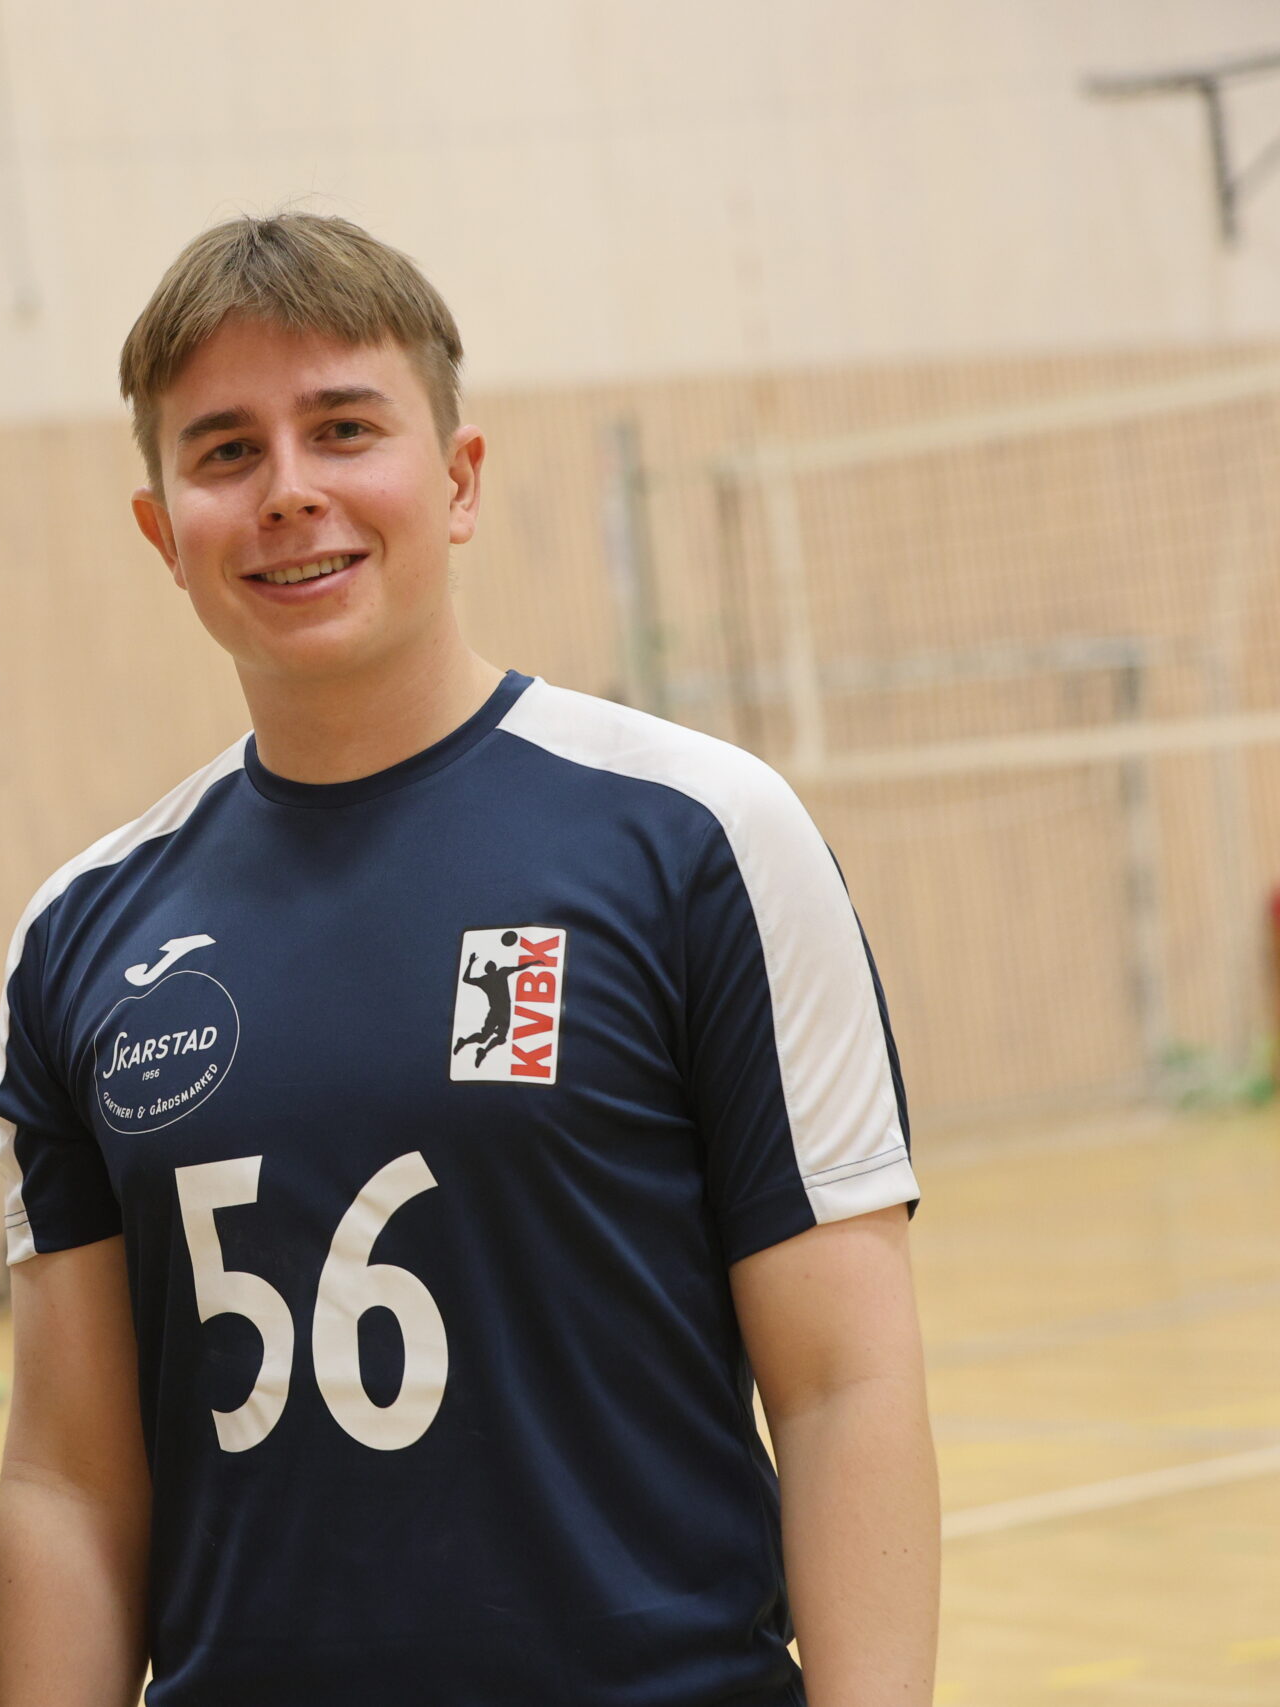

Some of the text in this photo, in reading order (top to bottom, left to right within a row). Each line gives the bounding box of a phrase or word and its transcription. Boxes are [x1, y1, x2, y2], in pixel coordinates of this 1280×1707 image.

[510, 935, 560, 1078] KVBK
[102, 1025, 218, 1080] SKARSTAD
[141, 1068, 160, 1081] 1956
[103, 1062, 219, 1119] GARTNERI & GÅRDSMARKED
[175, 1151, 448, 1452] 56
